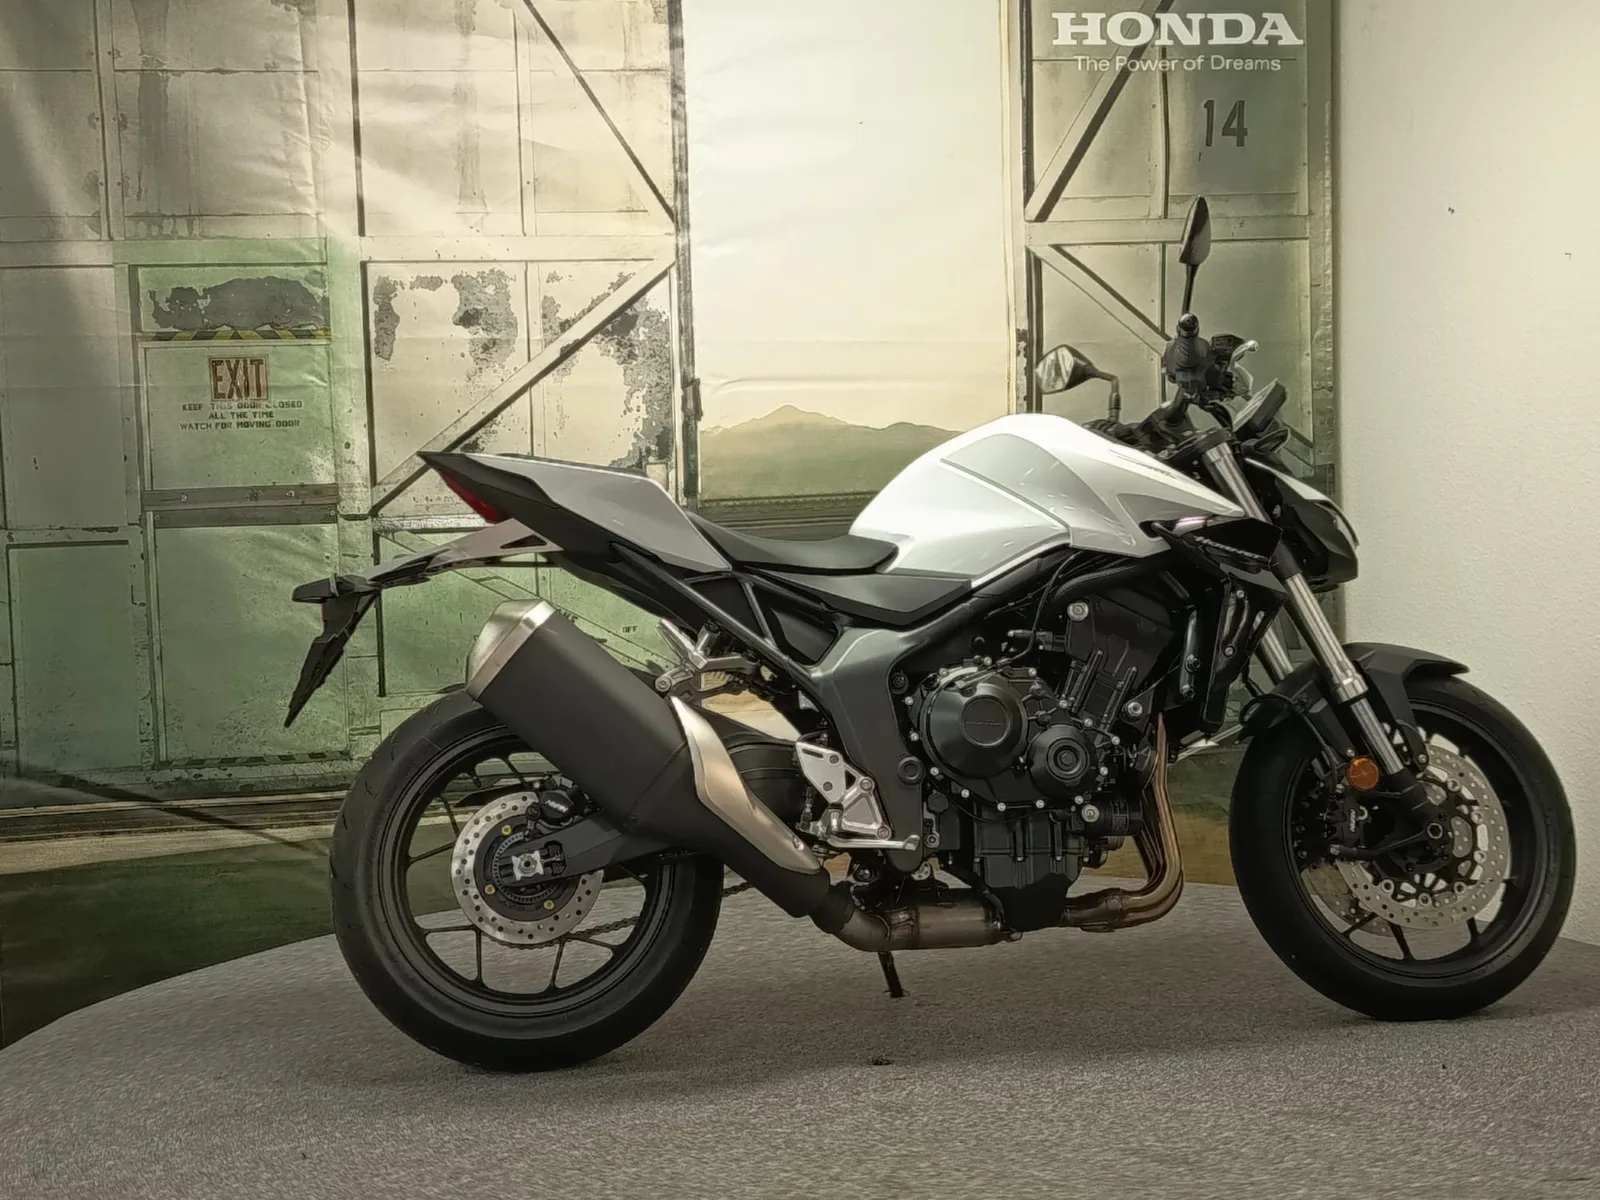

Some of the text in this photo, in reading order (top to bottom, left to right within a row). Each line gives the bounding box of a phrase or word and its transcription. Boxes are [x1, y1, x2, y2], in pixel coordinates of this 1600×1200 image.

[1051, 11, 1304, 46] HONDA
[1073, 55, 1281, 71] The Power of Dreams
[1203, 99, 1248, 147] 14
[211, 358, 264, 399] EXIT
[180, 419, 300, 430] WATCH FOR MOVING DOOR
[208, 410, 274, 420] ALL THE TIME
